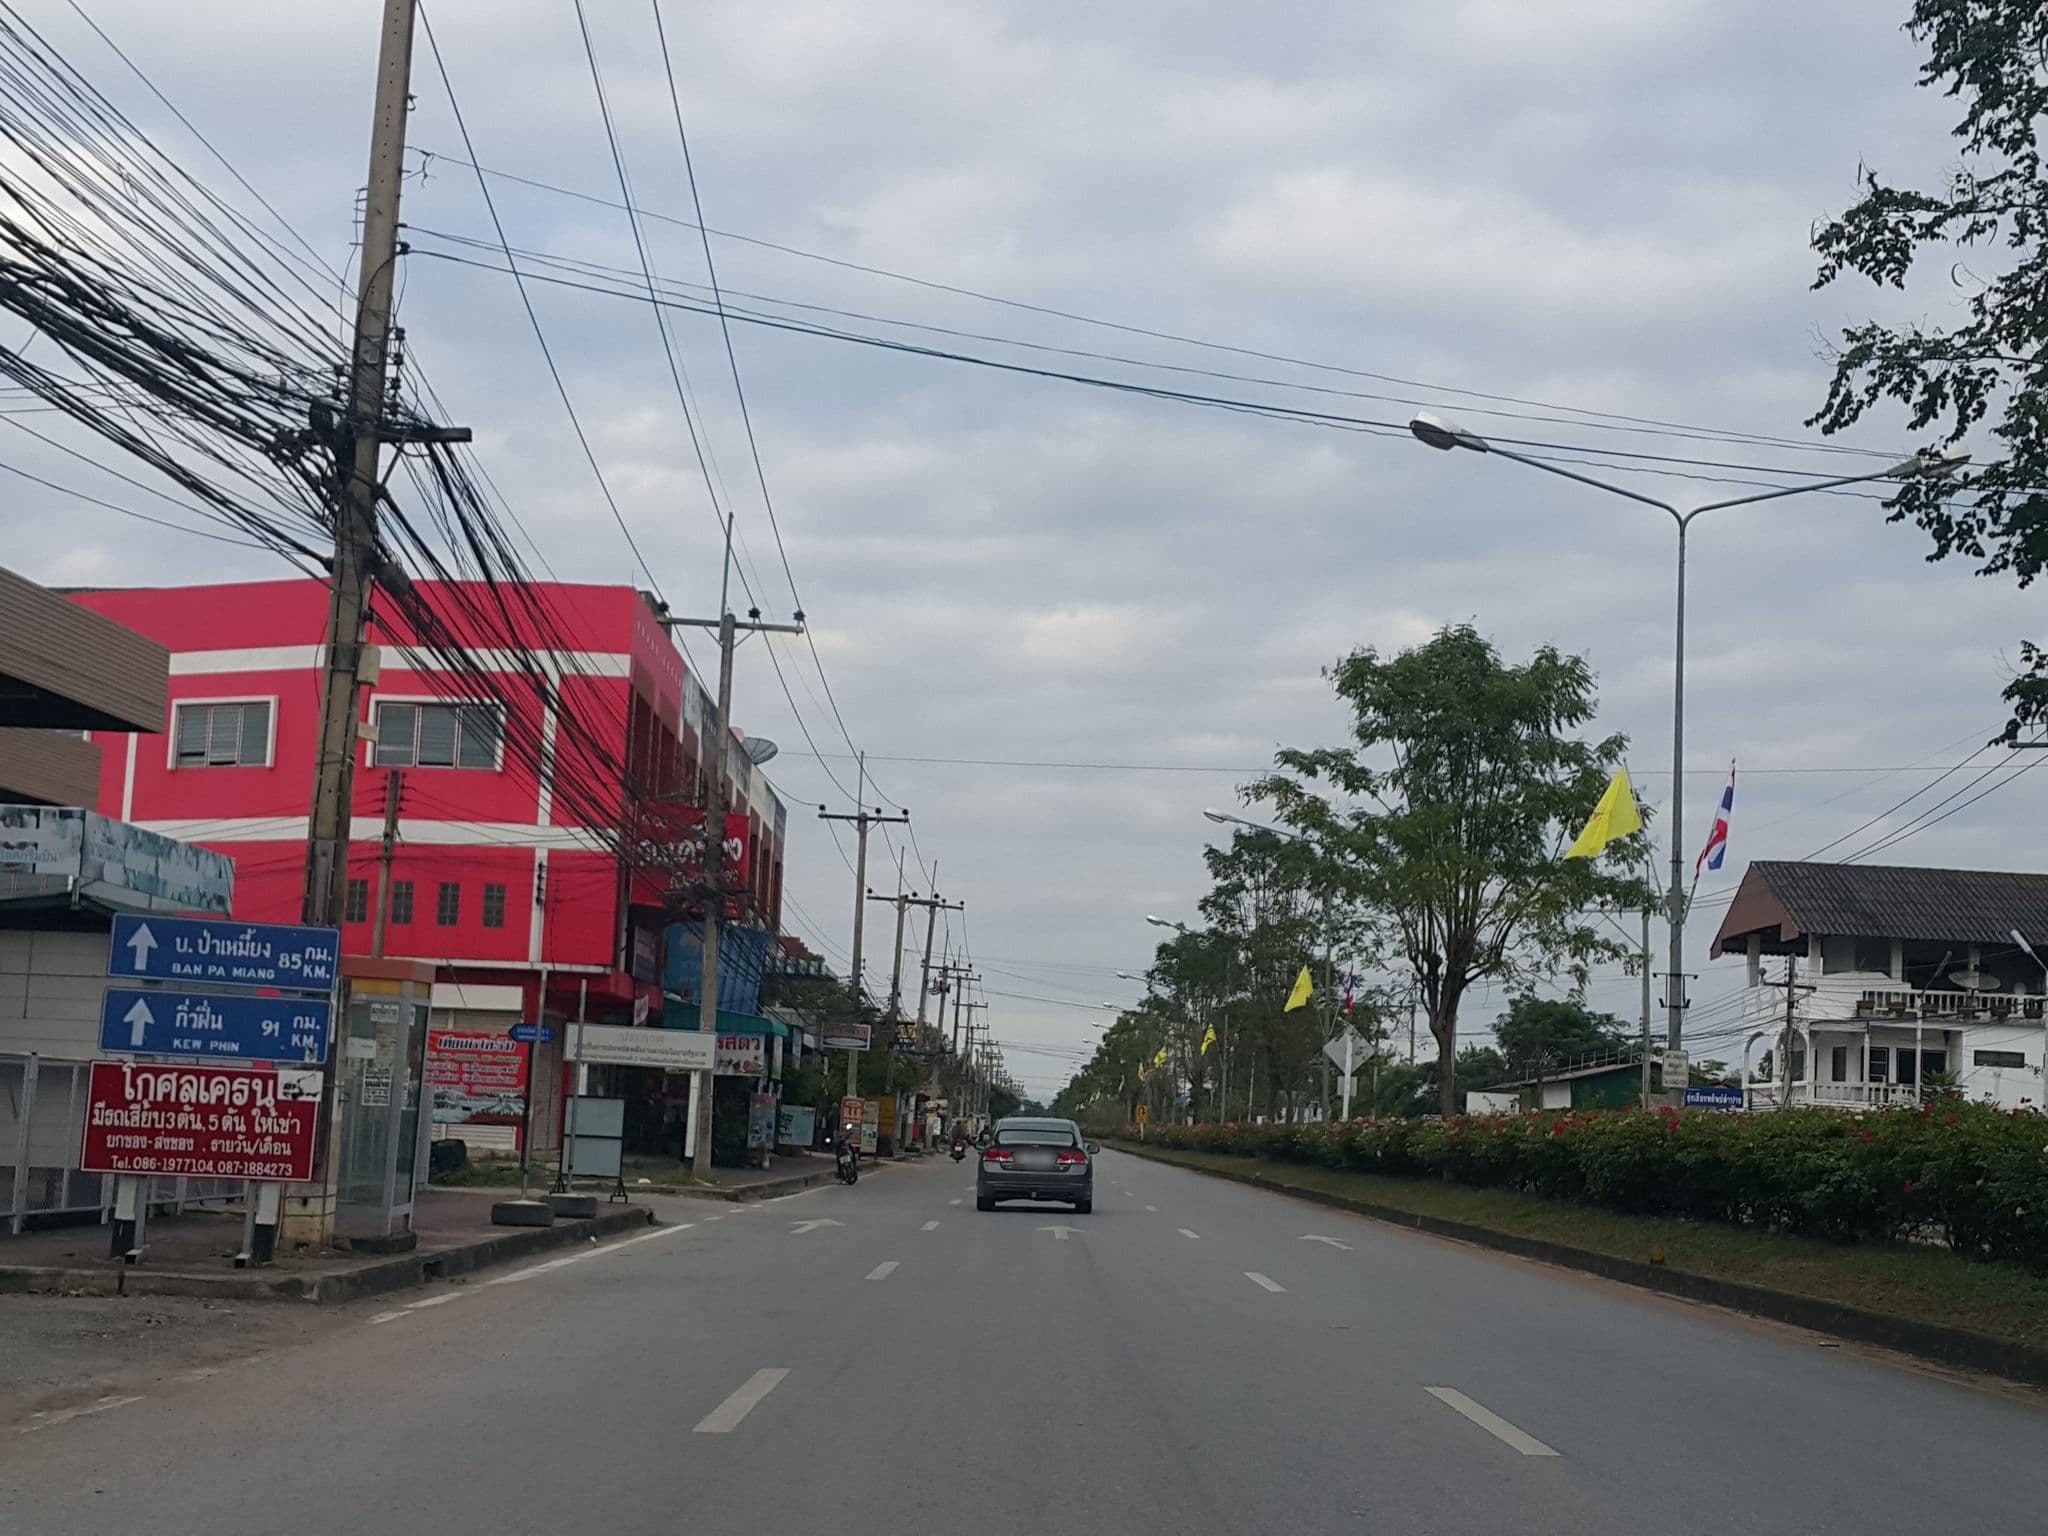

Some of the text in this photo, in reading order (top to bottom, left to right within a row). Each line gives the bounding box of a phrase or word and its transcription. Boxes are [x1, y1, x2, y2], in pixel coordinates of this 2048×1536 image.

[278, 952, 302, 970] 85
[304, 946, 333, 962] กม.
[171, 962, 331, 980] BAN PA MIANG KM.
[261, 1019, 280, 1037] 91
[292, 1015, 321, 1030] กม.
[173, 1037, 202, 1050] KEW
[209, 1039, 240, 1053] PHIN
[122, 1062, 276, 1109] โกศลเครน
